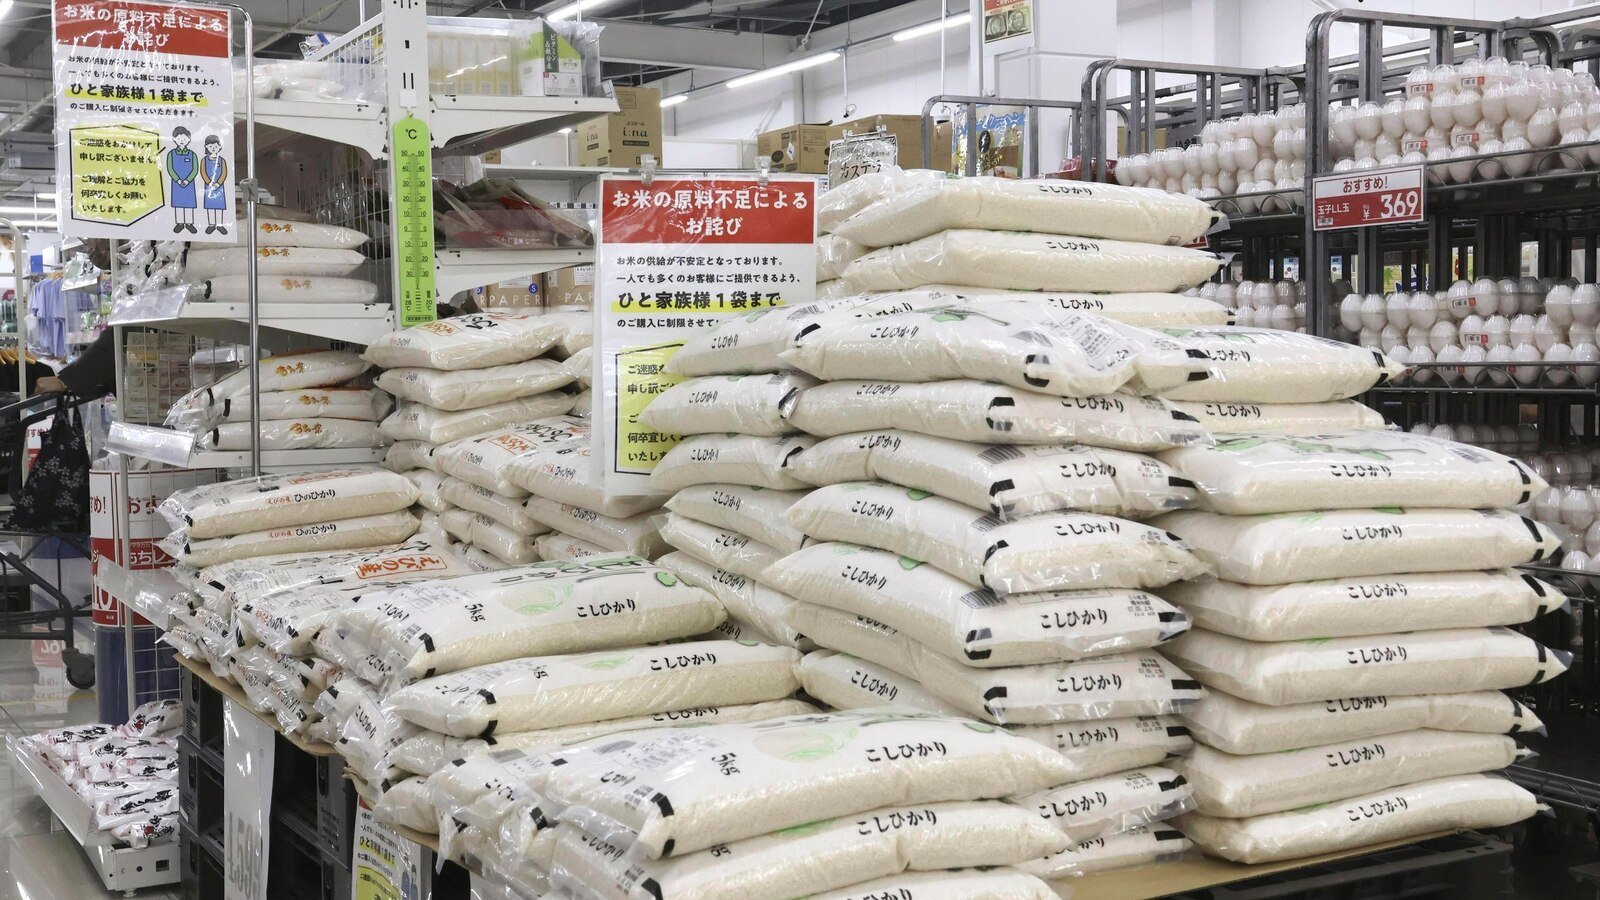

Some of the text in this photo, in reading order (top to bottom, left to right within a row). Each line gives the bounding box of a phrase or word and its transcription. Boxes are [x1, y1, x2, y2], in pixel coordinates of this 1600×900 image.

[64, 4, 222, 31] お米の原料不足による
[68, 70, 220, 87] 一も多くのお客様にご提供できるよう、
[70, 83, 204, 103] ひと家族様1袋まで
[81, 175, 146, 186] ご理解とご協力を
[1343, 176, 1388, 193] おすすめ!
[1038, 185, 1093, 195] こしひかり
[613, 189, 808, 210] お米の原料不足による
[1380, 191, 1419, 218] 369
[82, 204, 127, 214] いたします。
[1317, 202, 1350, 215] 玉子LL玉
[686, 217, 743, 236] お詫び
[1046, 241, 1100, 251] こしひかり
[616, 256, 784, 266] お米の供給が不安定となっております。
[616, 273, 800, 284] 一人でも多くのお客様にご提供できるよう、
[618, 291, 782, 309] ひと家族様1袋まで
[617, 318, 719, 328] のご購入に制限させて
[871, 326, 919, 339] こしひかり
[711, 335, 739, 349] こしひかり
[689, 391, 718, 404] こしひかり
[856, 384, 901, 395] こしひかり
[1061, 395, 1124, 413] こしひかり
[1205, 403, 1261, 418] こしひかり
[858, 435, 902, 451] こしひかり
[690, 449, 720, 461] こしひかり
[1060, 462, 1117, 478] こしひかり
[1331, 464, 1392, 478] こしひかり
[294, 489, 336, 502] ひのひかり
[712, 491, 742, 510] こしひかり
[851, 500, 894, 520] こしひかり
[295, 524, 337, 536] ひのひかり
[1054, 521, 1121, 536] こしひかり
[1342, 525, 1403, 541] こしひかり
[715, 533, 749, 548] こしひかり
[712, 569, 746, 589] こしひかり
[841, 565, 887, 589] こしひかり
[1347, 583, 1408, 599] こしひかり
[465, 603, 486, 622] 5kg
[577, 599, 636, 618] こしひかり
[1040, 609, 1108, 629] こしひかり
[650, 653, 717, 671] こしひかり
[1347, 646, 1408, 665] こしひかり
[851, 670, 898, 700] こしひかり
[1057, 674, 1122, 693] こしひかり
[1326, 695, 1388, 713] こしひかり
[1056, 727, 1119, 748] こしひかり
[866, 742, 947, 763] こしひかり
[1327, 744, 1386, 767] こしひかり
[1039, 792, 1108, 819] こしひかり
[1347, 797, 1409, 822] こしひかり
[857, 810, 937, 835] こしひかり
